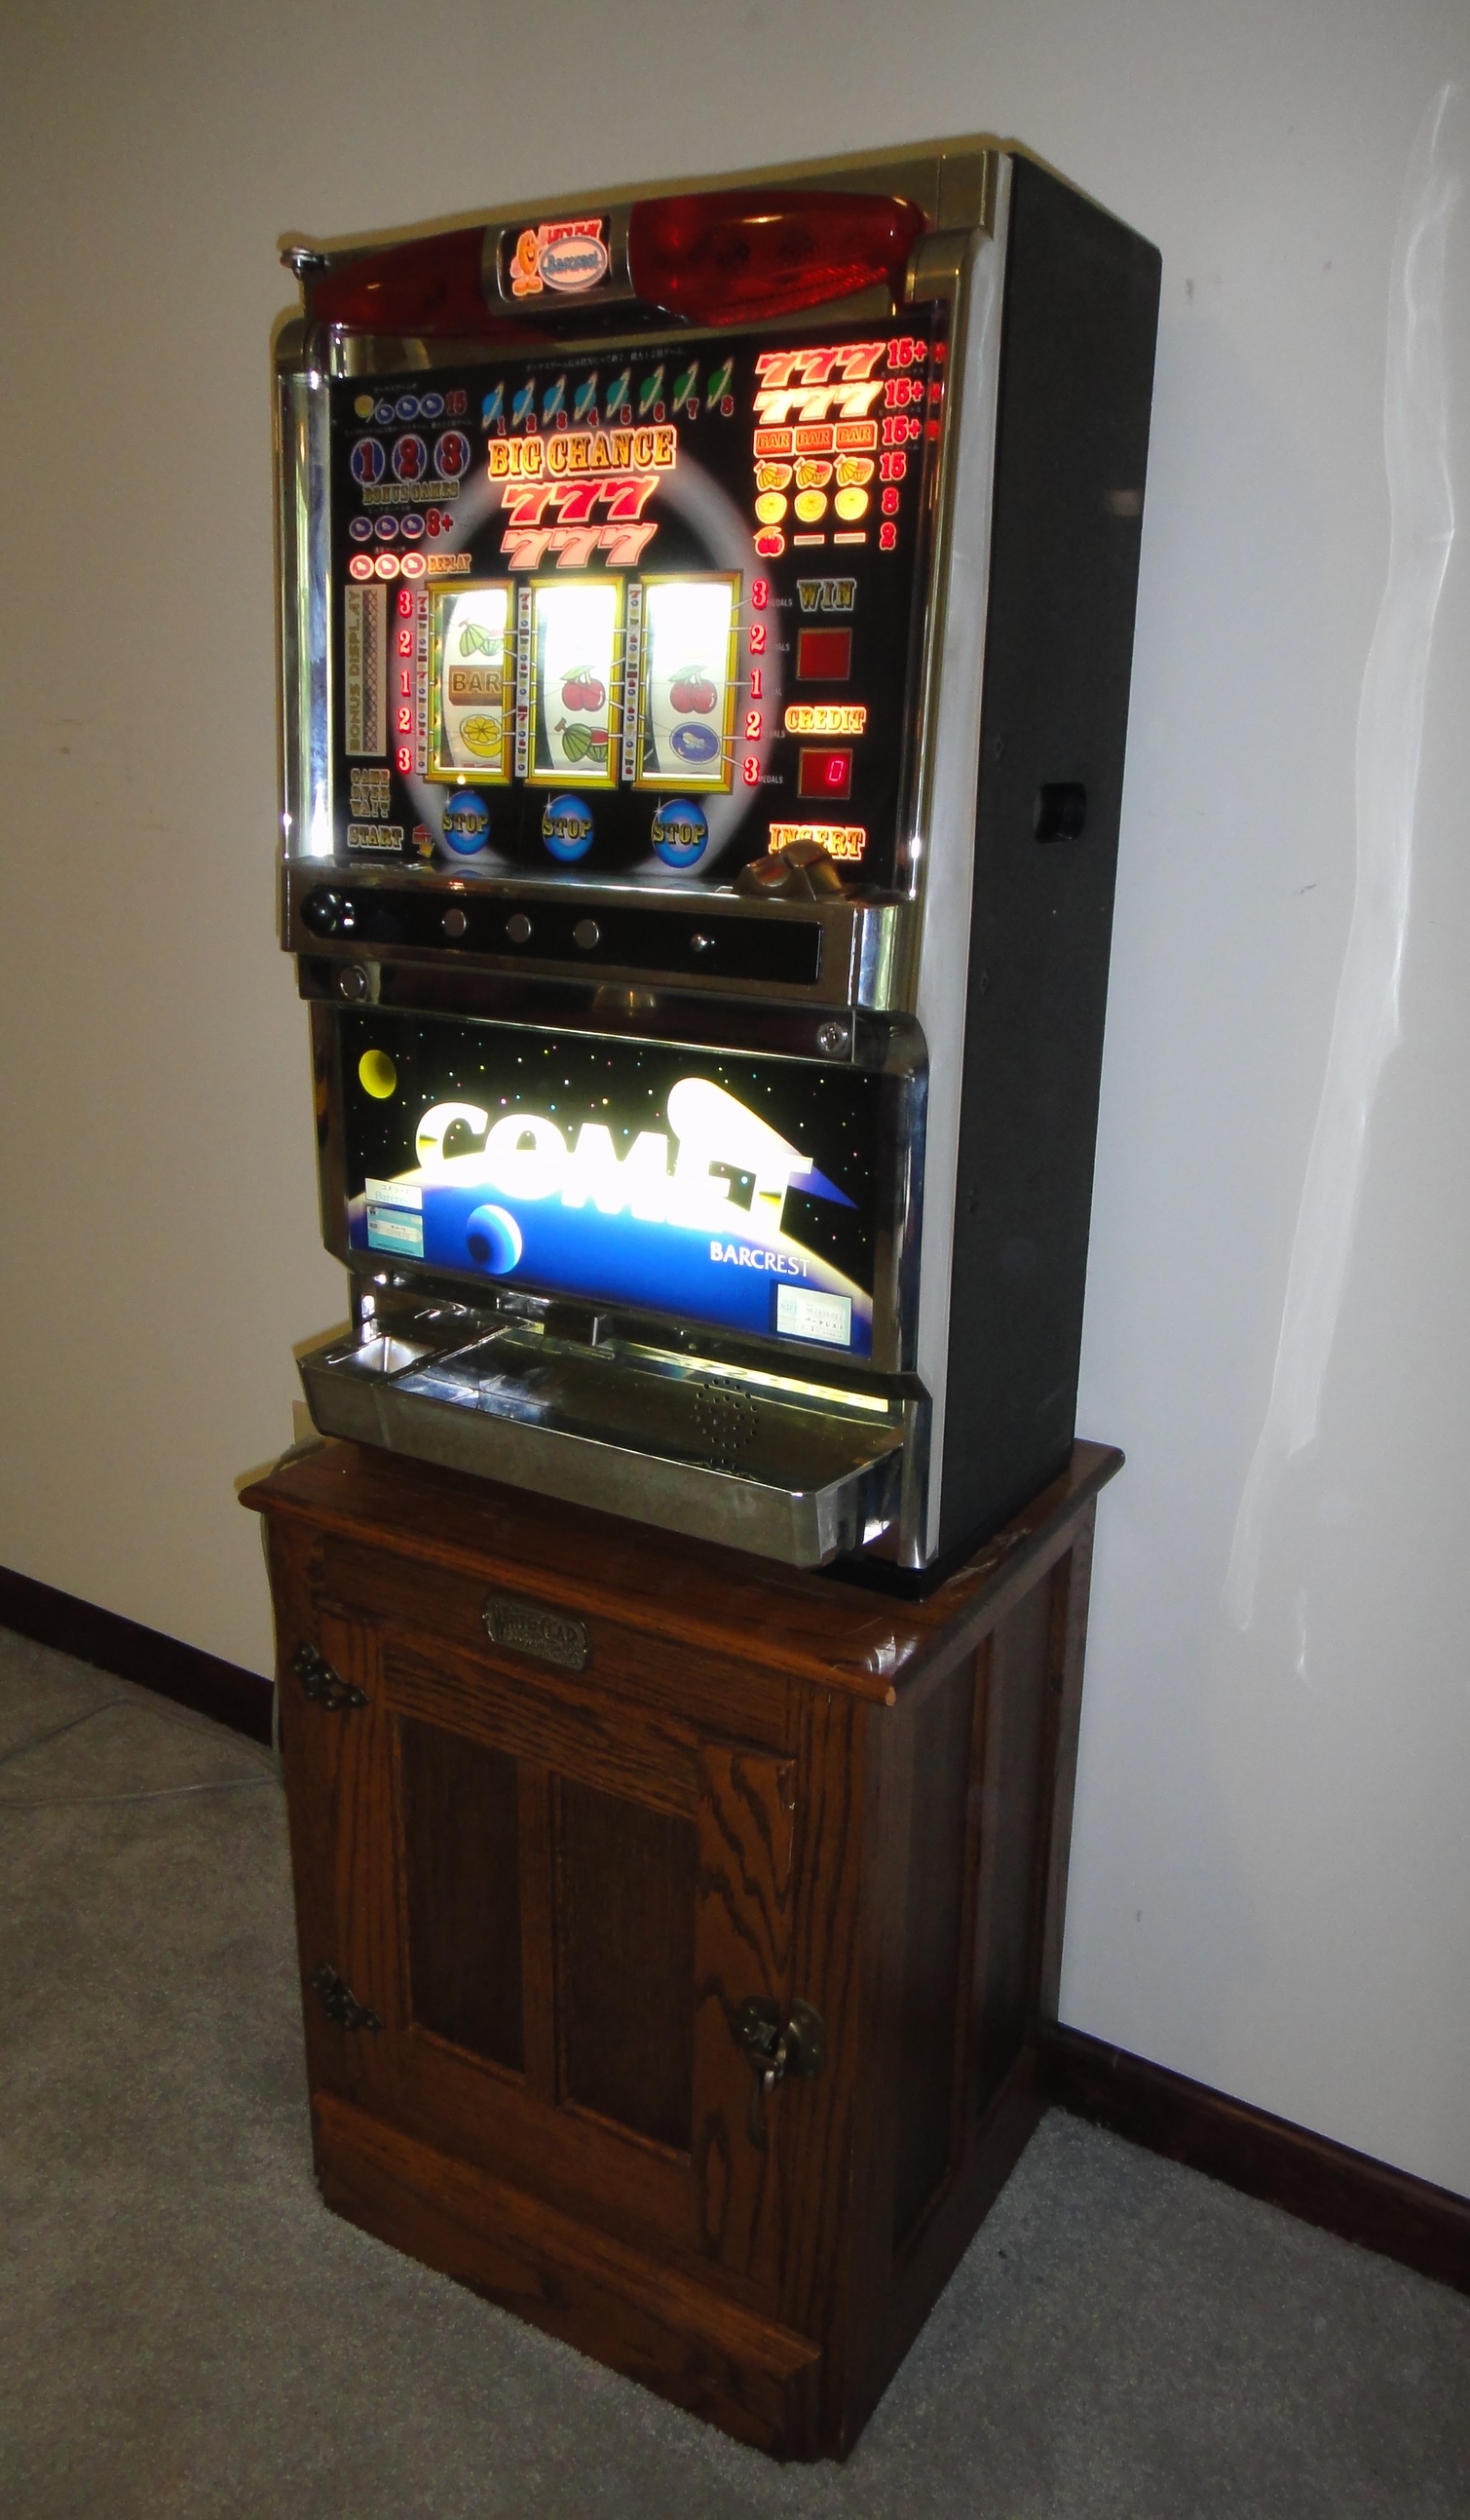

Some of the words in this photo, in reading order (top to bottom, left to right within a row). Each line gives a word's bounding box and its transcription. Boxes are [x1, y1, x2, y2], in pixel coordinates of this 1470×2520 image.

[758, 433, 790, 448] BAR
[797, 430, 830, 445] BAR
[839, 427, 871, 442] BAR
[359, 439, 376, 483] 1
[488, 437, 544, 481] BIG
[547, 425, 677, 477] CHANCE
[880, 451, 907, 481] 15
[362, 483, 410, 505] BONUS
[410, 479, 460, 503] GAMES
[501, 476, 660, 525] 777
[501, 523, 658, 569] 777
[428, 554, 471, 574] REPLAY
[397, 590, 412, 618] 3
[752, 579, 769, 610] 3
[796, 578, 856, 612] WIN
[348, 591, 360, 677] DISPLAY
[397, 630, 412, 657] 2
[749, 624, 766, 655] 2
[400, 669, 410, 698] 1
[451, 670, 502, 694] BAR
[750, 668, 762, 699] 1
[348, 683, 360, 752] BONUS
[398, 706, 411, 734] 2
[745, 710, 762, 741] 2
[784, 706, 866, 734] CREDIT
[398, 746, 411, 775] 3
[743, 756, 759, 785] 3
[828, 759, 845, 782] 0
[351, 768, 390, 784] GAME
[351, 785, 390, 801] OVER
[350, 799, 389, 818] WAIT
[442, 812, 488, 833] STOP
[348, 823, 403, 850] START
[543, 813, 593, 839] STOP
[652, 821, 705, 845] STOP
[416, 1077, 813, 1242] COMET
[710, 1241, 810, 1277] BARCREST
